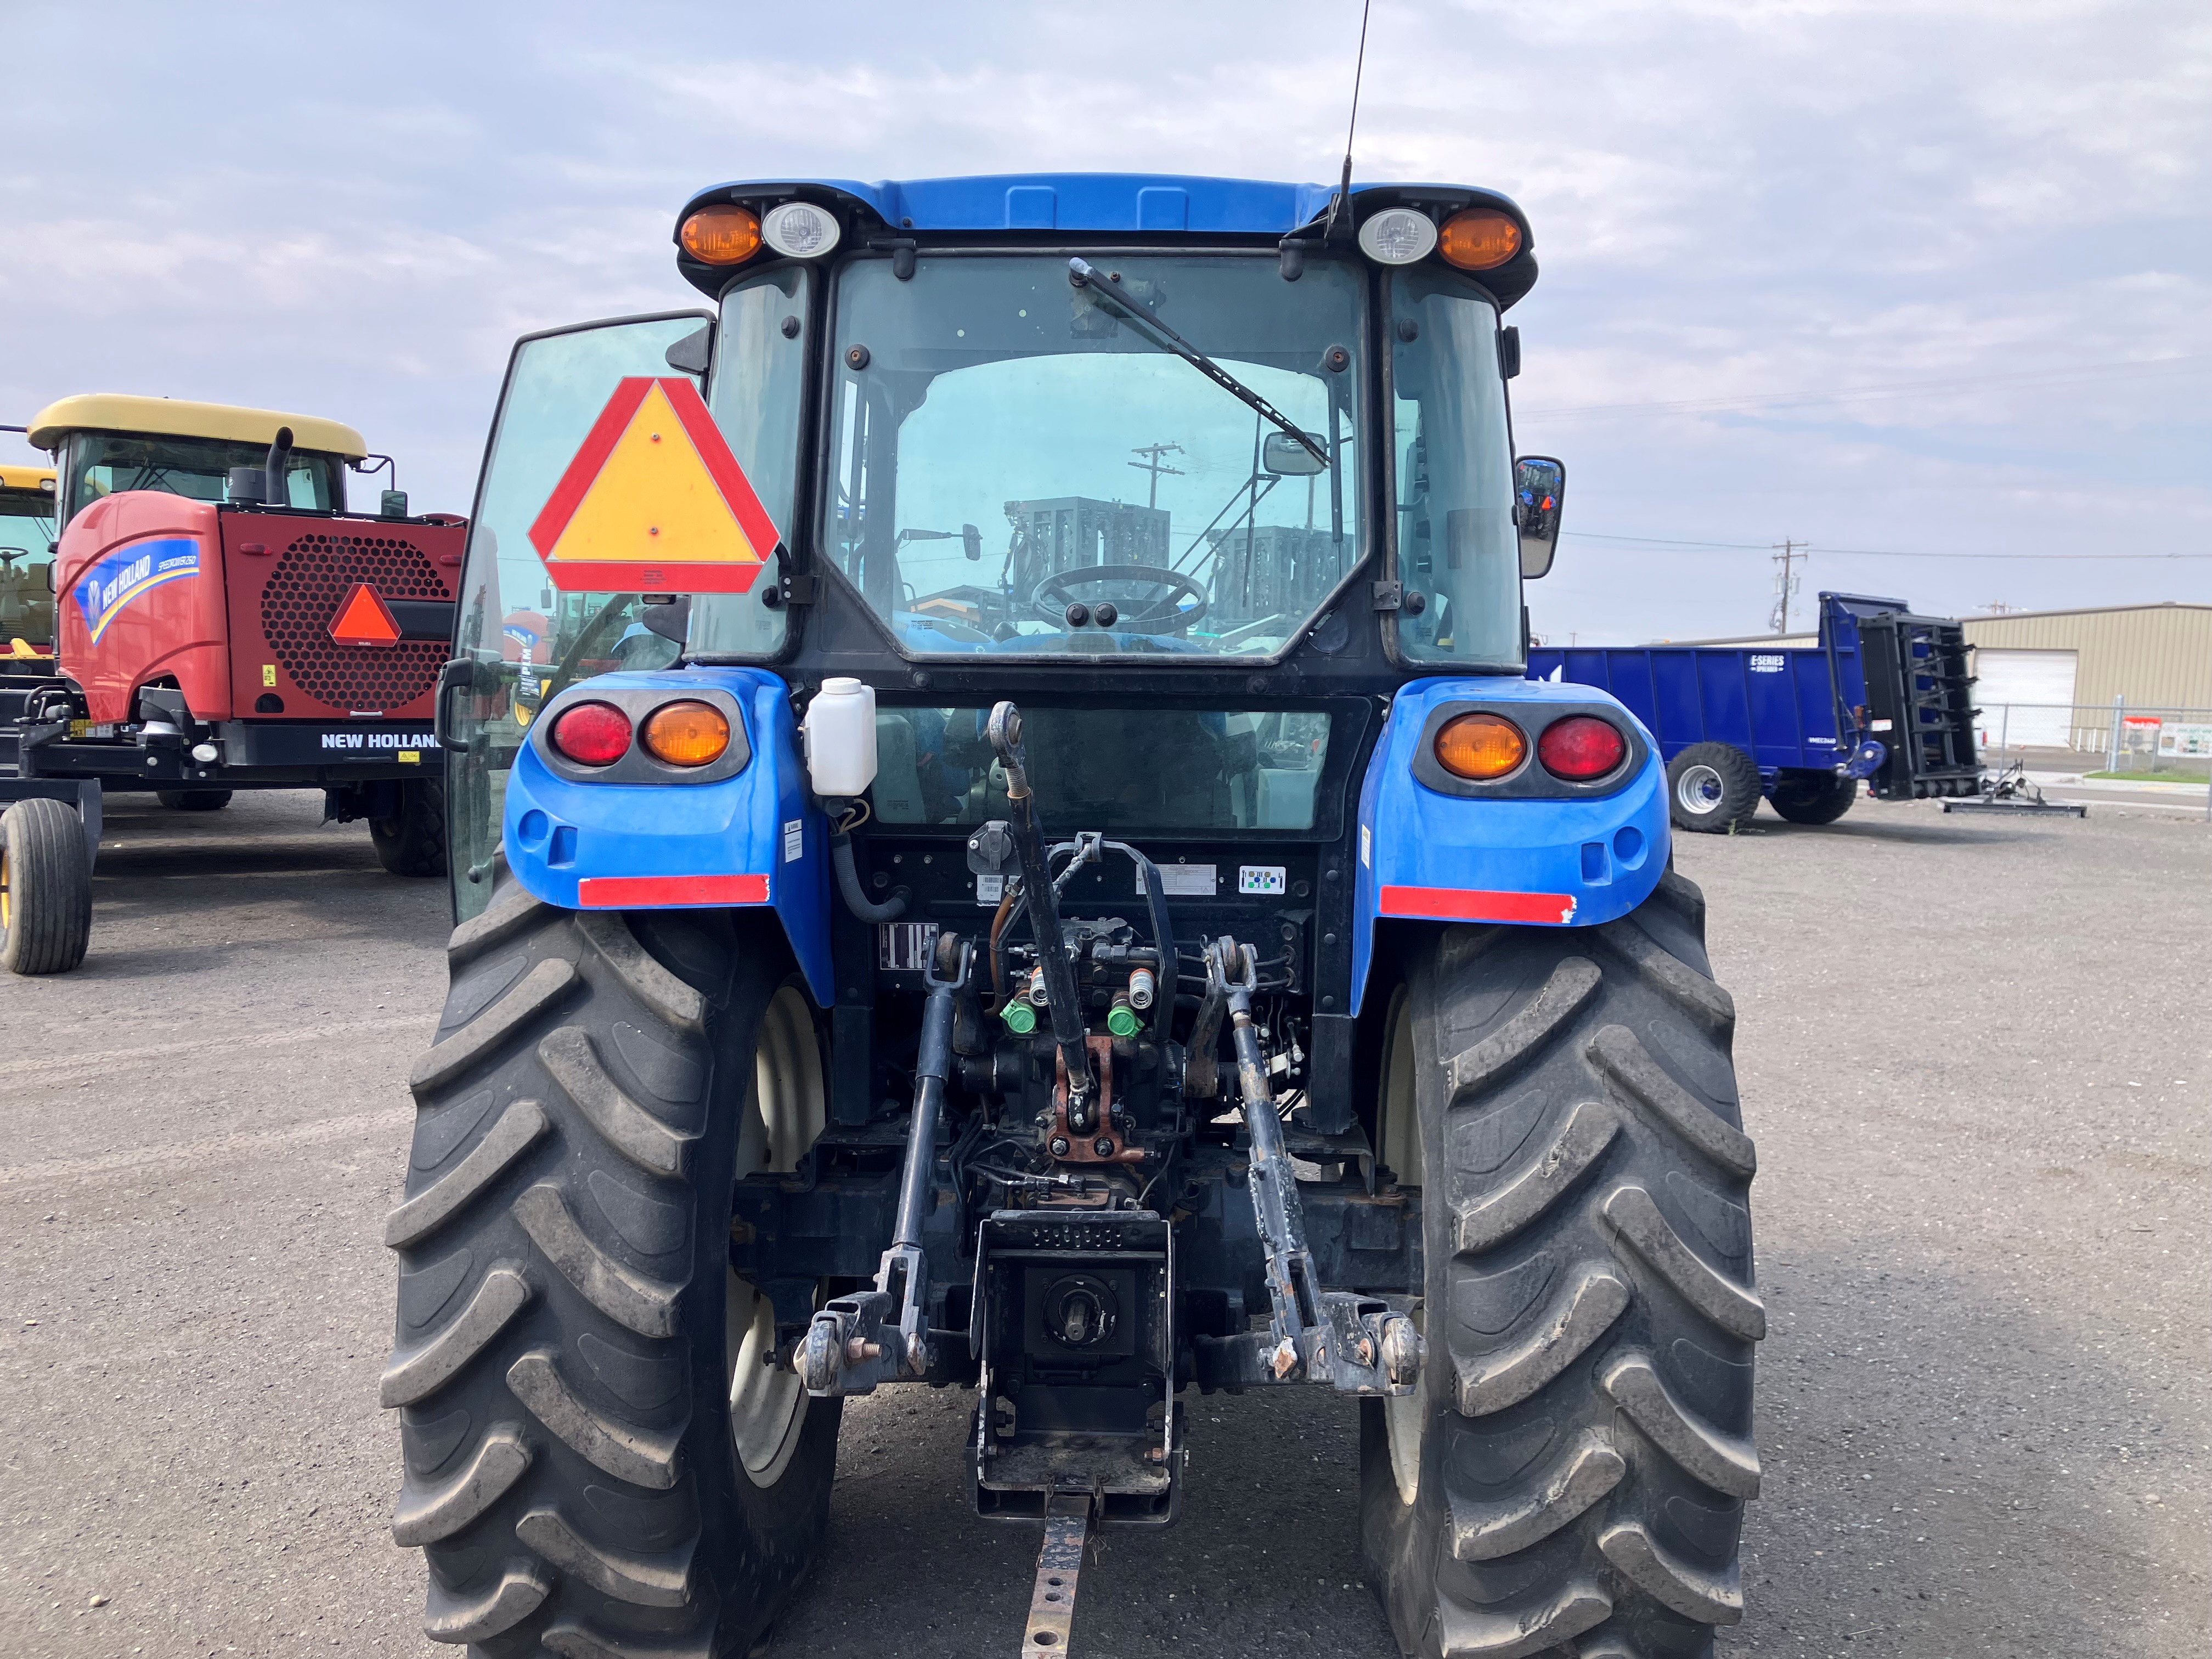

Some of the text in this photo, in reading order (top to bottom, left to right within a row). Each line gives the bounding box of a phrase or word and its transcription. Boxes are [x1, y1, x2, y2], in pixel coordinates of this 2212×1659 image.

[103, 554, 150, 611] NEW HOLLAND
[1750, 654, 1785, 667] E-SERIES
[321, 734, 363, 748] NEW
